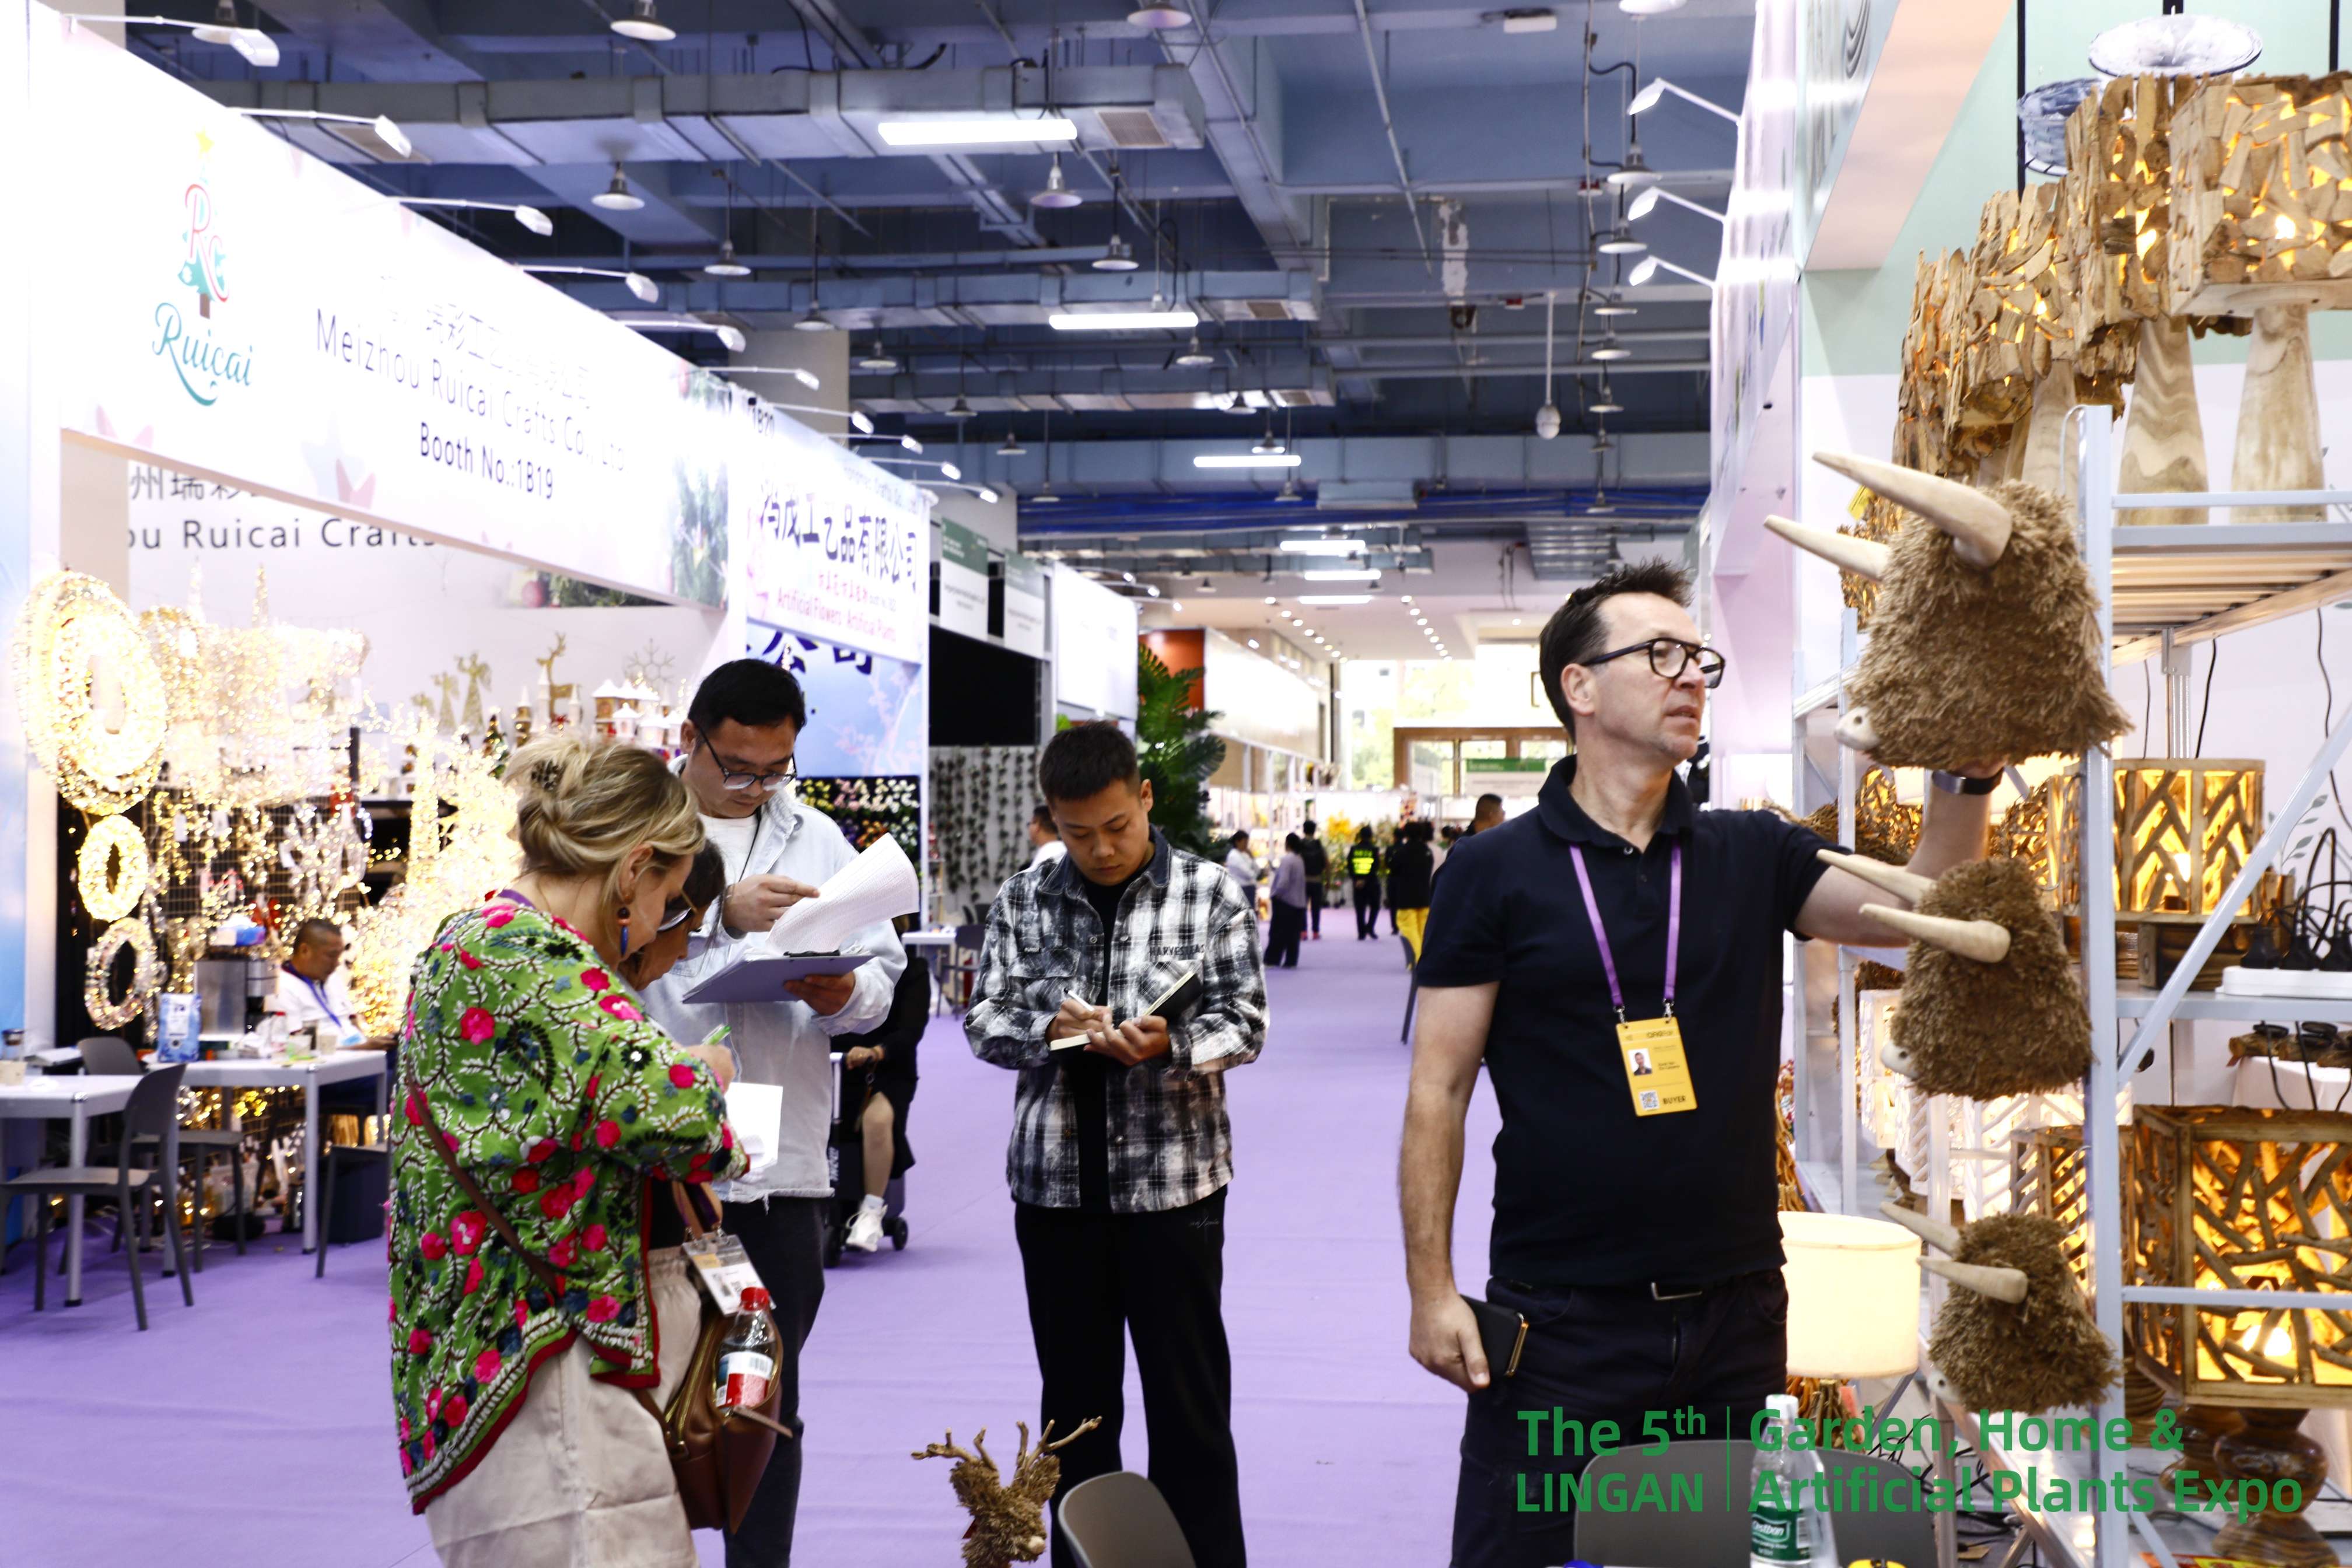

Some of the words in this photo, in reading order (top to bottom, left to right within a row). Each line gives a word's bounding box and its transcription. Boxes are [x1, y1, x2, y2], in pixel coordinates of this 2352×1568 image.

[152, 302, 253, 407] Ruicai
[317, 308, 420, 390] Meizhou
[432, 358, 494, 420] Ruicai
[503, 390, 556, 445] Crafts
[419, 421, 474, 474] Booth
[183, 518, 300, 549] Ruicai
[1662, 1096, 1686, 1105] BUYER
